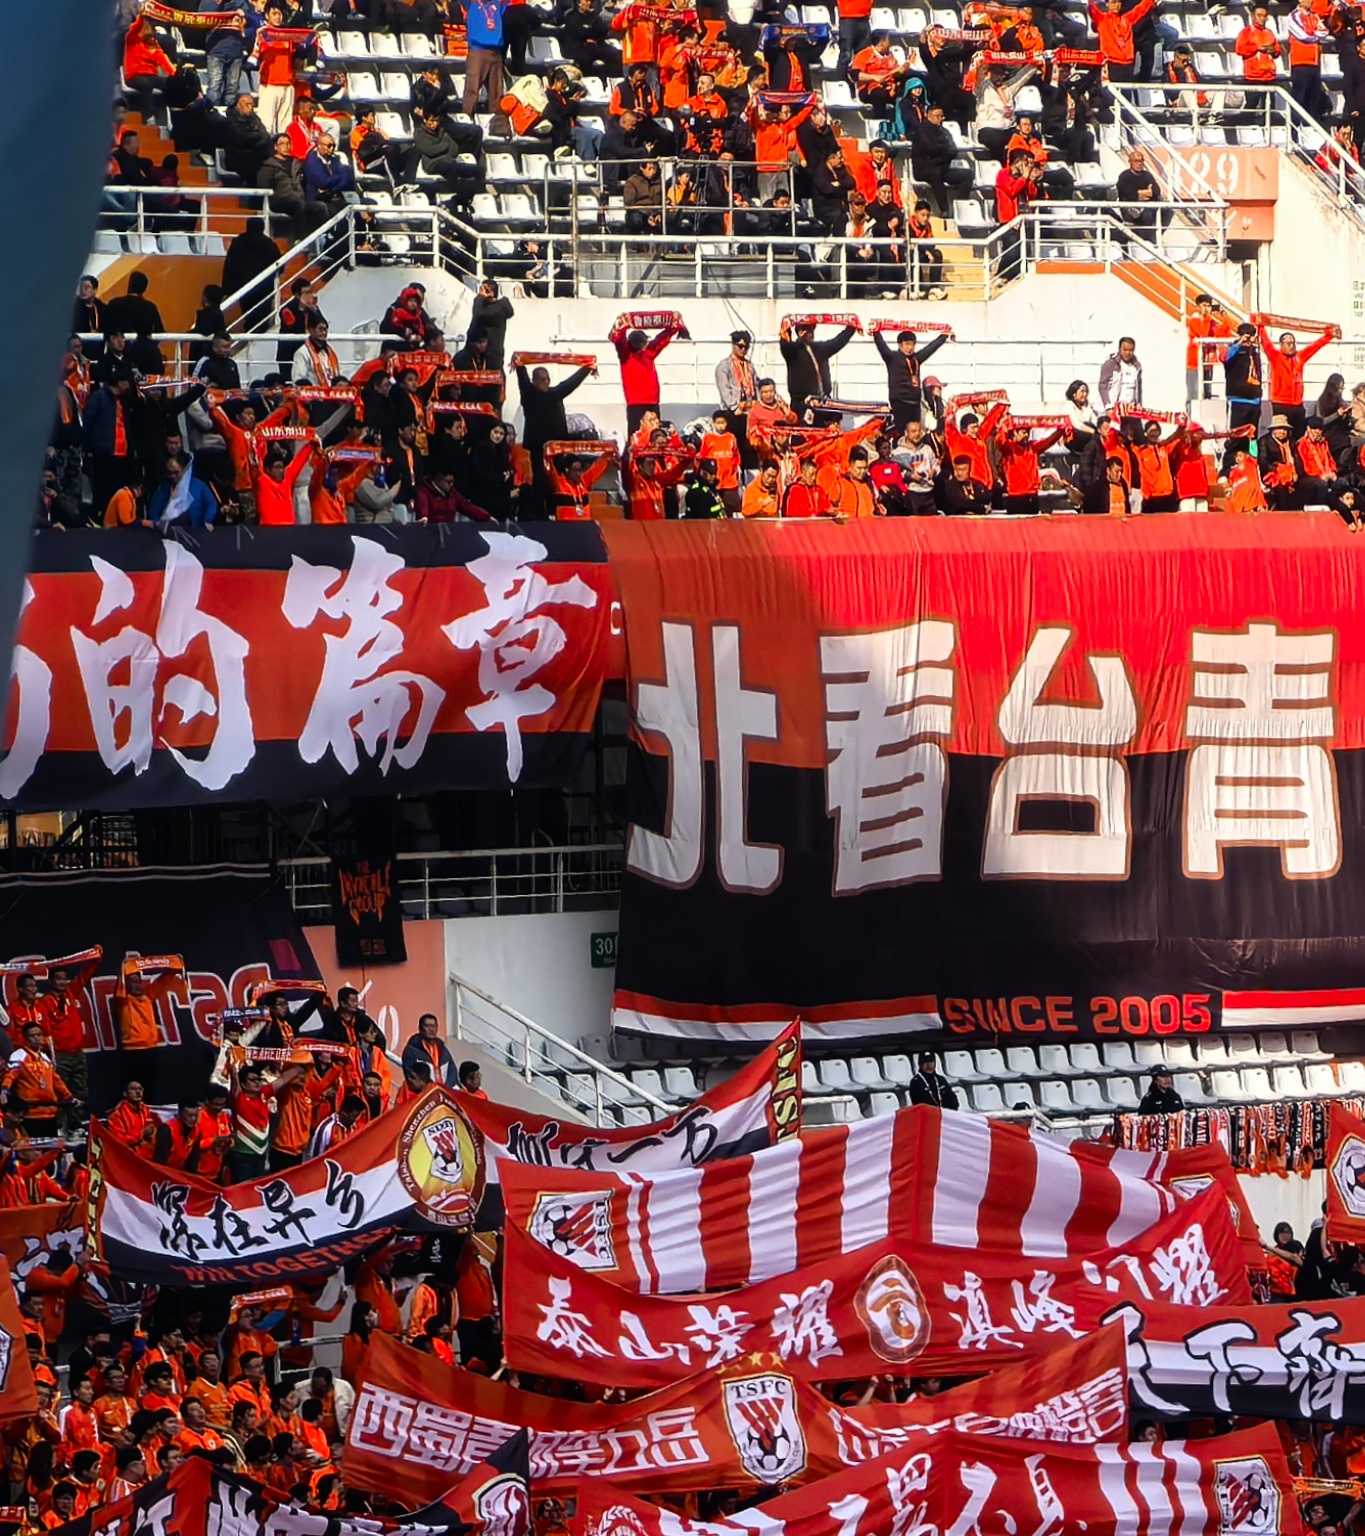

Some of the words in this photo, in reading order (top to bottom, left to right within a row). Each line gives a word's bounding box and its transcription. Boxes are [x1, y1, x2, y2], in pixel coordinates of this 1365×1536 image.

[943, 997, 1074, 1035] SINCE
[1089, 993, 1212, 1035] 2005
[728, 1380, 788, 1399] TSFC
